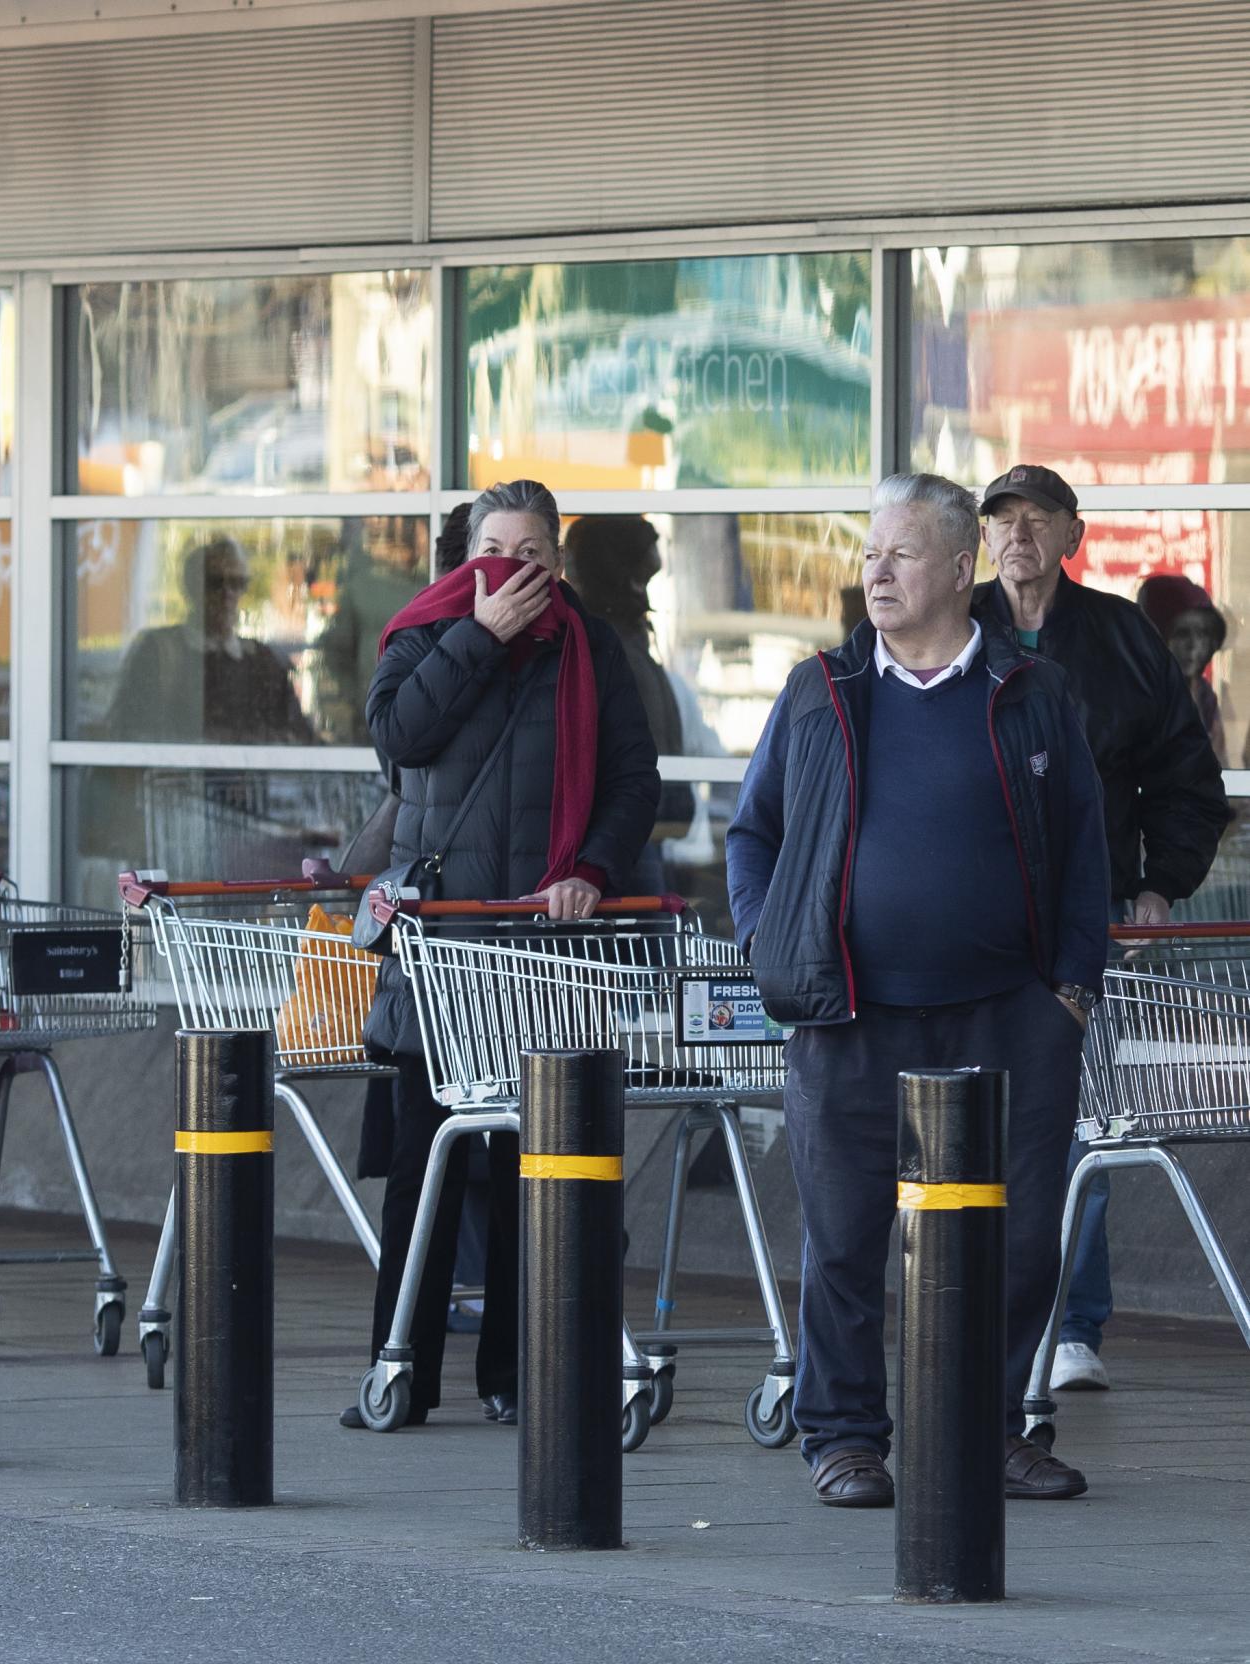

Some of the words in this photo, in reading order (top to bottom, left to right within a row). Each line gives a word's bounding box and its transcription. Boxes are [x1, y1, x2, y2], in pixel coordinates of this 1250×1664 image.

[46, 945, 98, 957] Sainsbury's
[713, 985, 760, 997] FRESH
[738, 1003, 761, 1012] DAY
